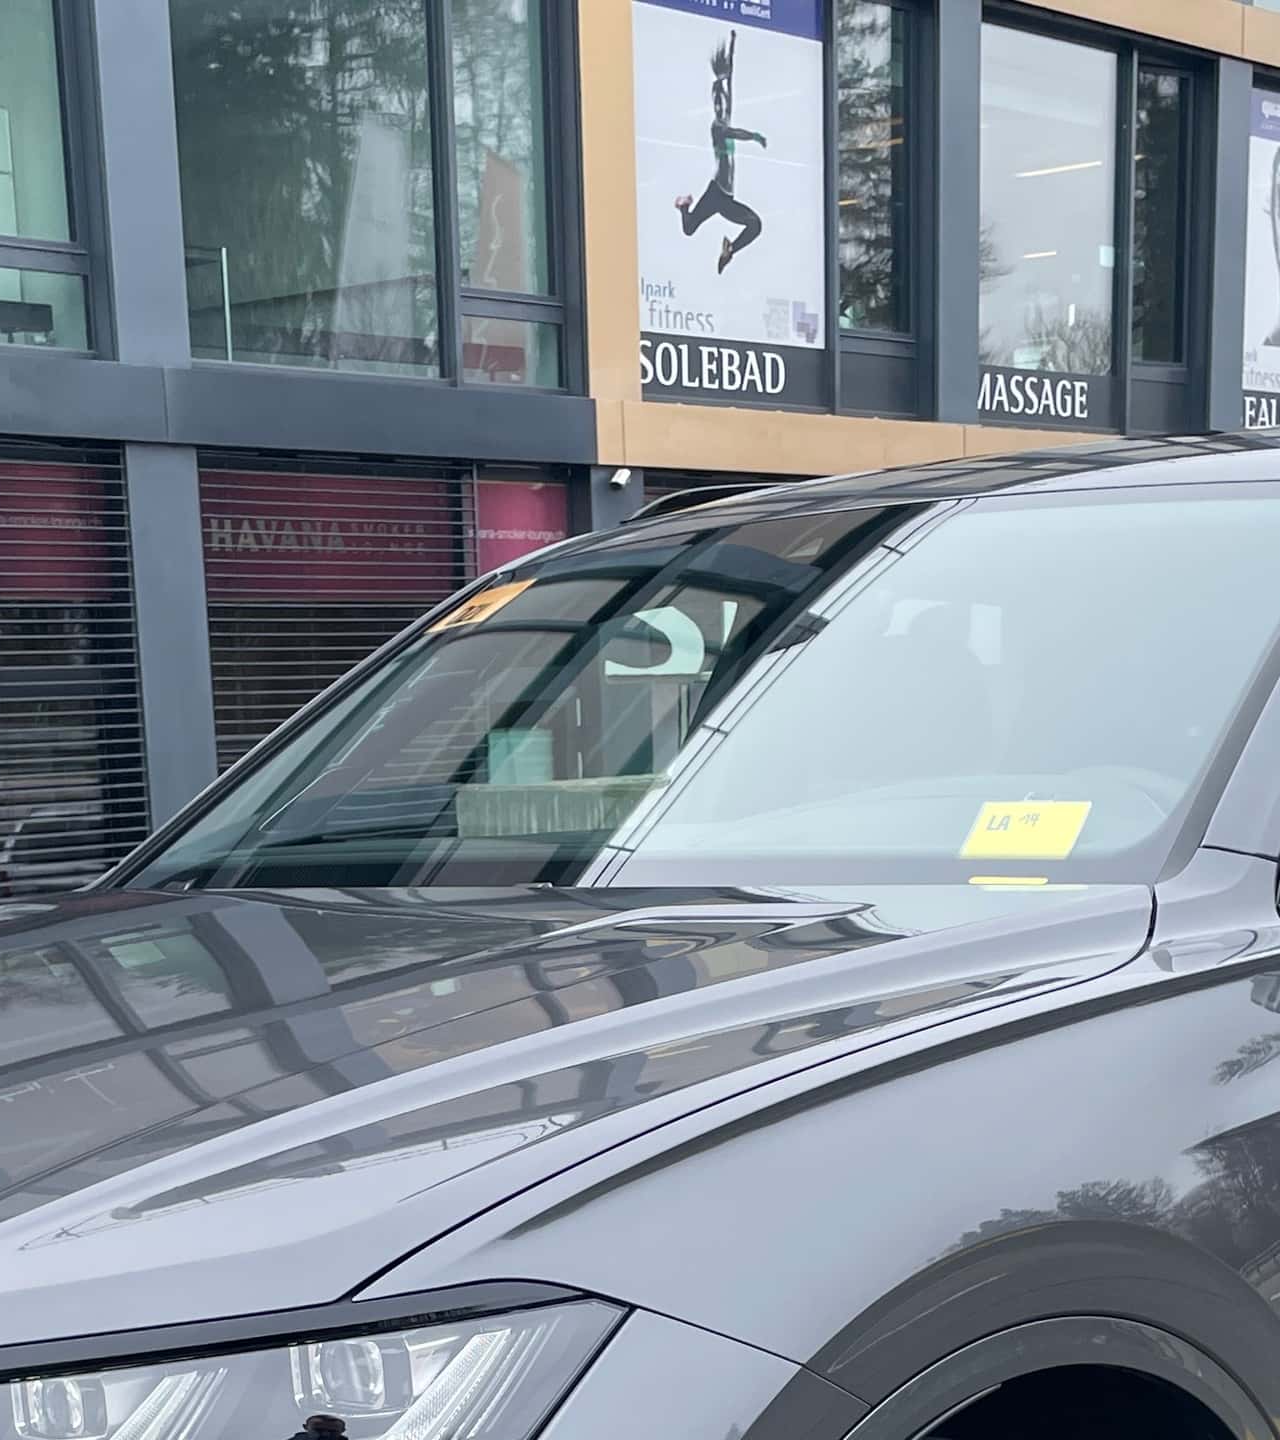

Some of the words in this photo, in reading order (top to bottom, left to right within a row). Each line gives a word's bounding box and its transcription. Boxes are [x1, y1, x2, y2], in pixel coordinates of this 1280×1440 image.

[648, 300, 714, 332] fitness
[640, 340, 786, 394] SOLEBAD
[210, 518, 347, 553] HAVANA
